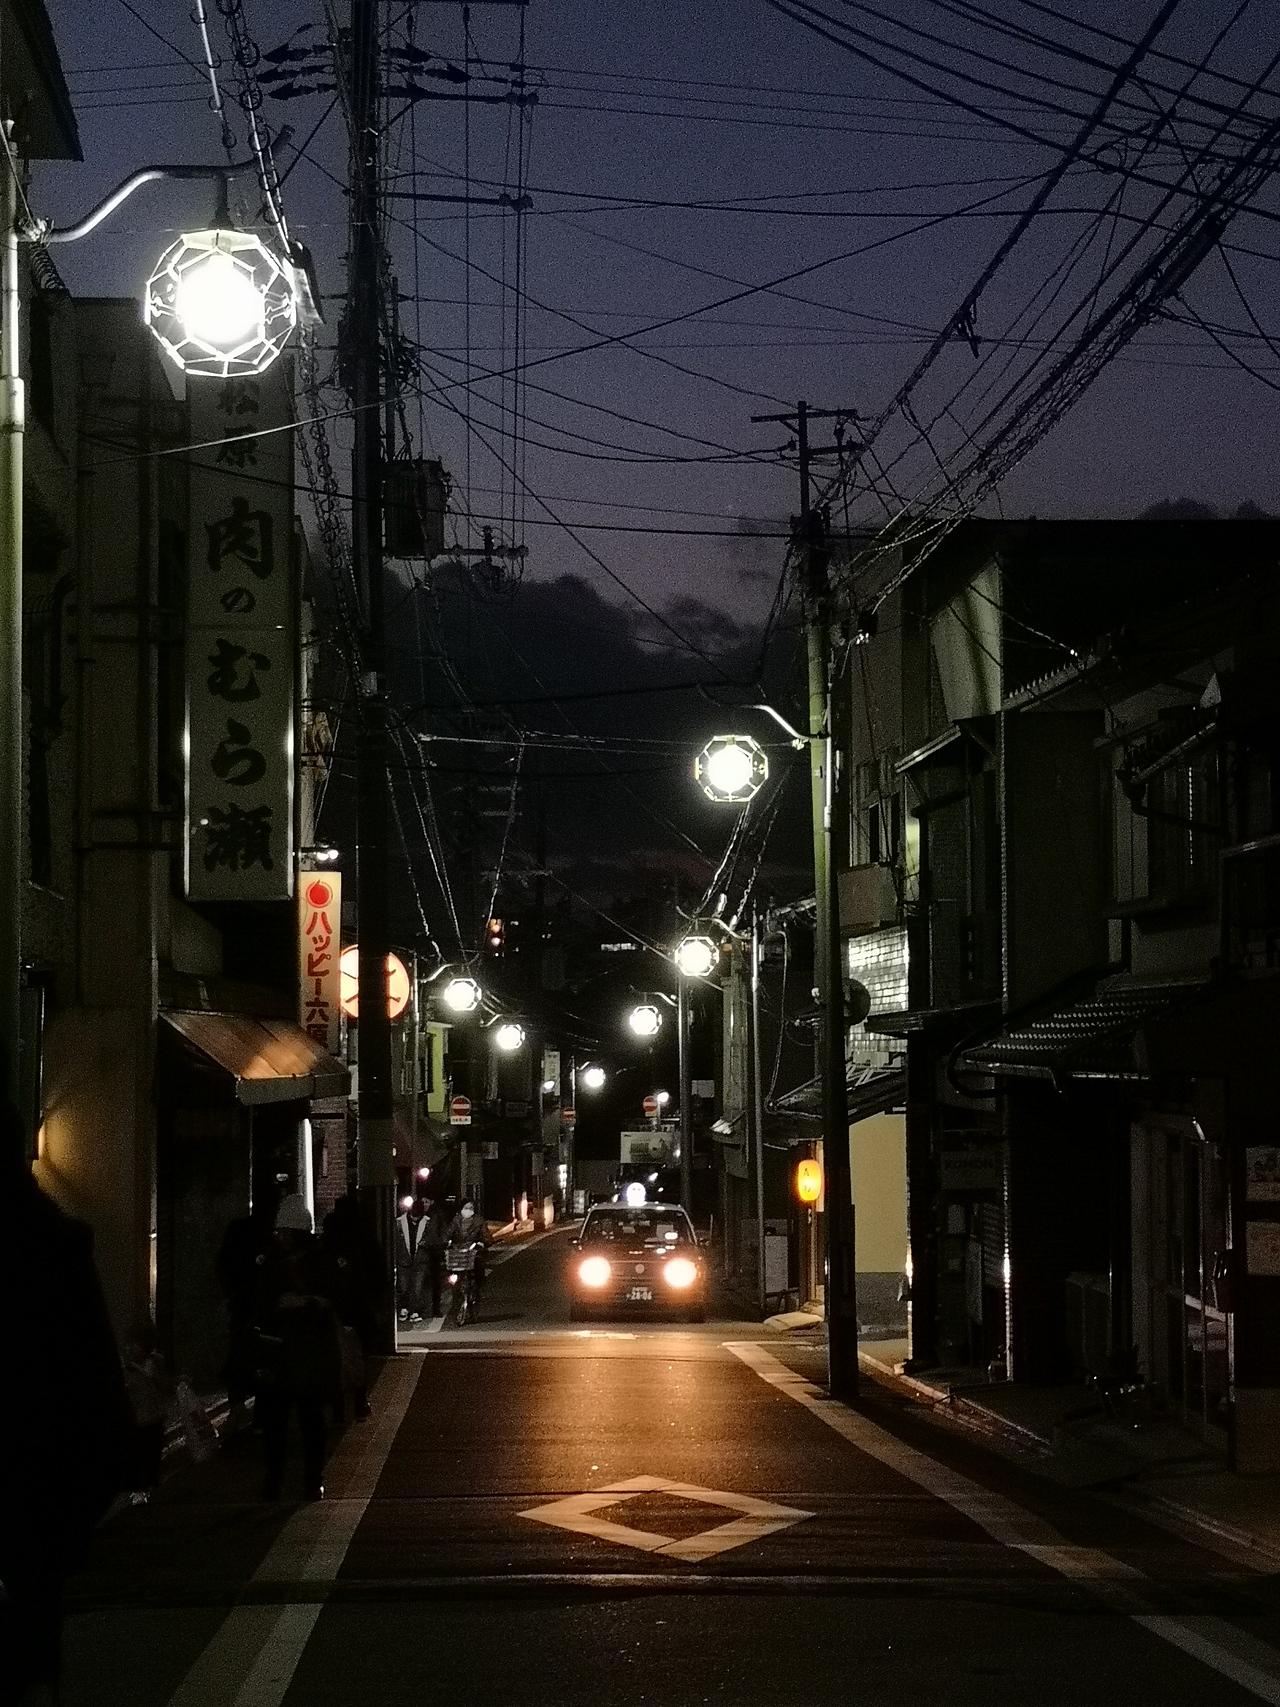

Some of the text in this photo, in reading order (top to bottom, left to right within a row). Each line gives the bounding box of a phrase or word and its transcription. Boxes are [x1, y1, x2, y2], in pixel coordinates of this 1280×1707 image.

[203, 495, 274, 873] 肉のむら瀬
